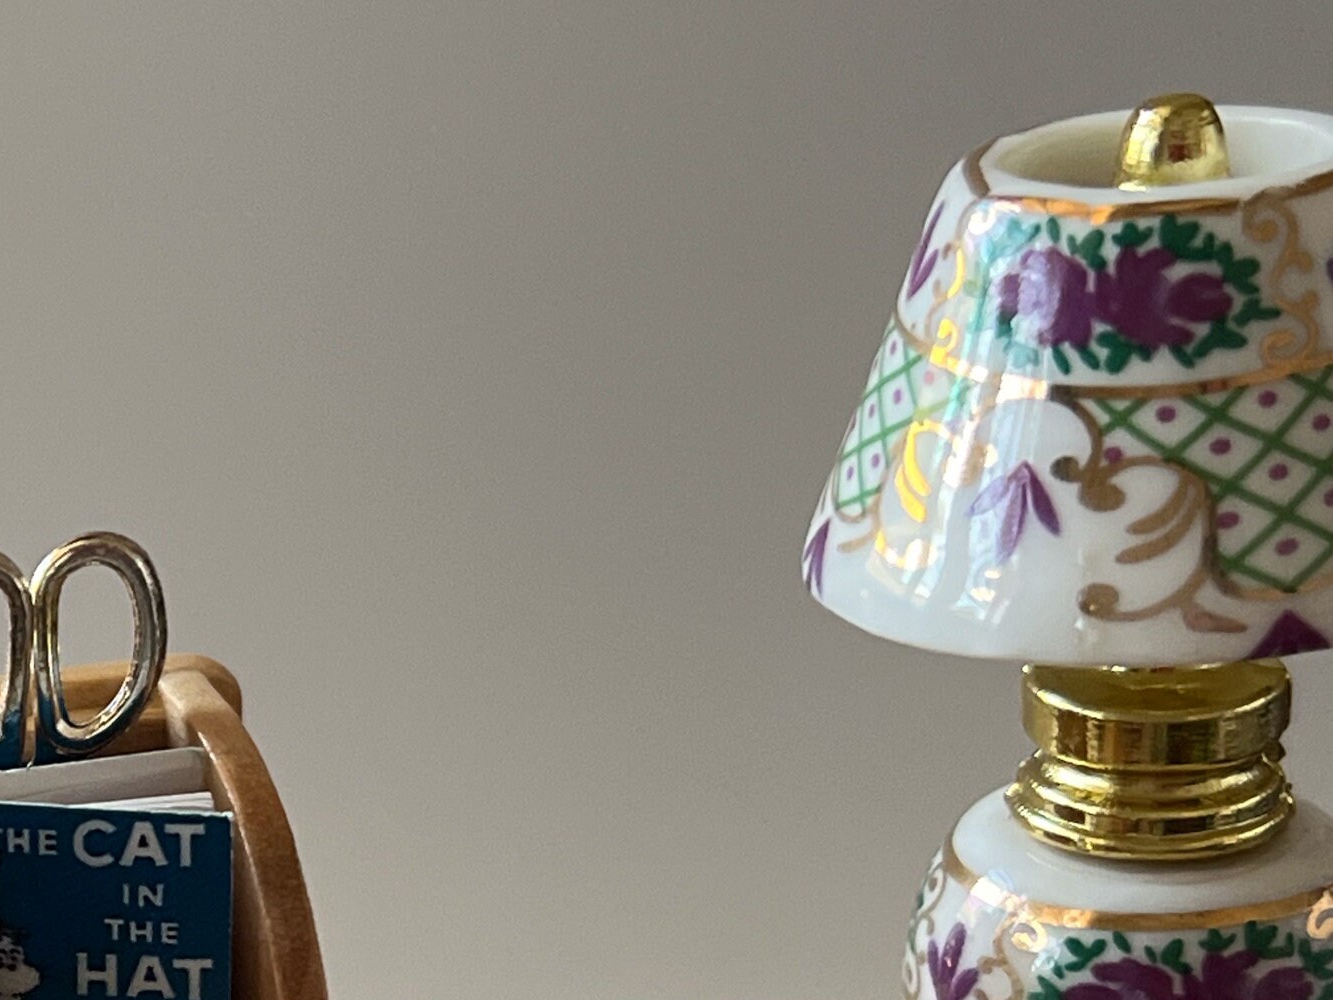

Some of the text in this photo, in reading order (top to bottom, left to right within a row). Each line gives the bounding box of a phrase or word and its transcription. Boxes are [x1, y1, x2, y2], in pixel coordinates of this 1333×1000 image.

[72, 818, 206, 868] CAT
[121, 882, 165, 908] IN
[103, 918, 180, 946] THE
